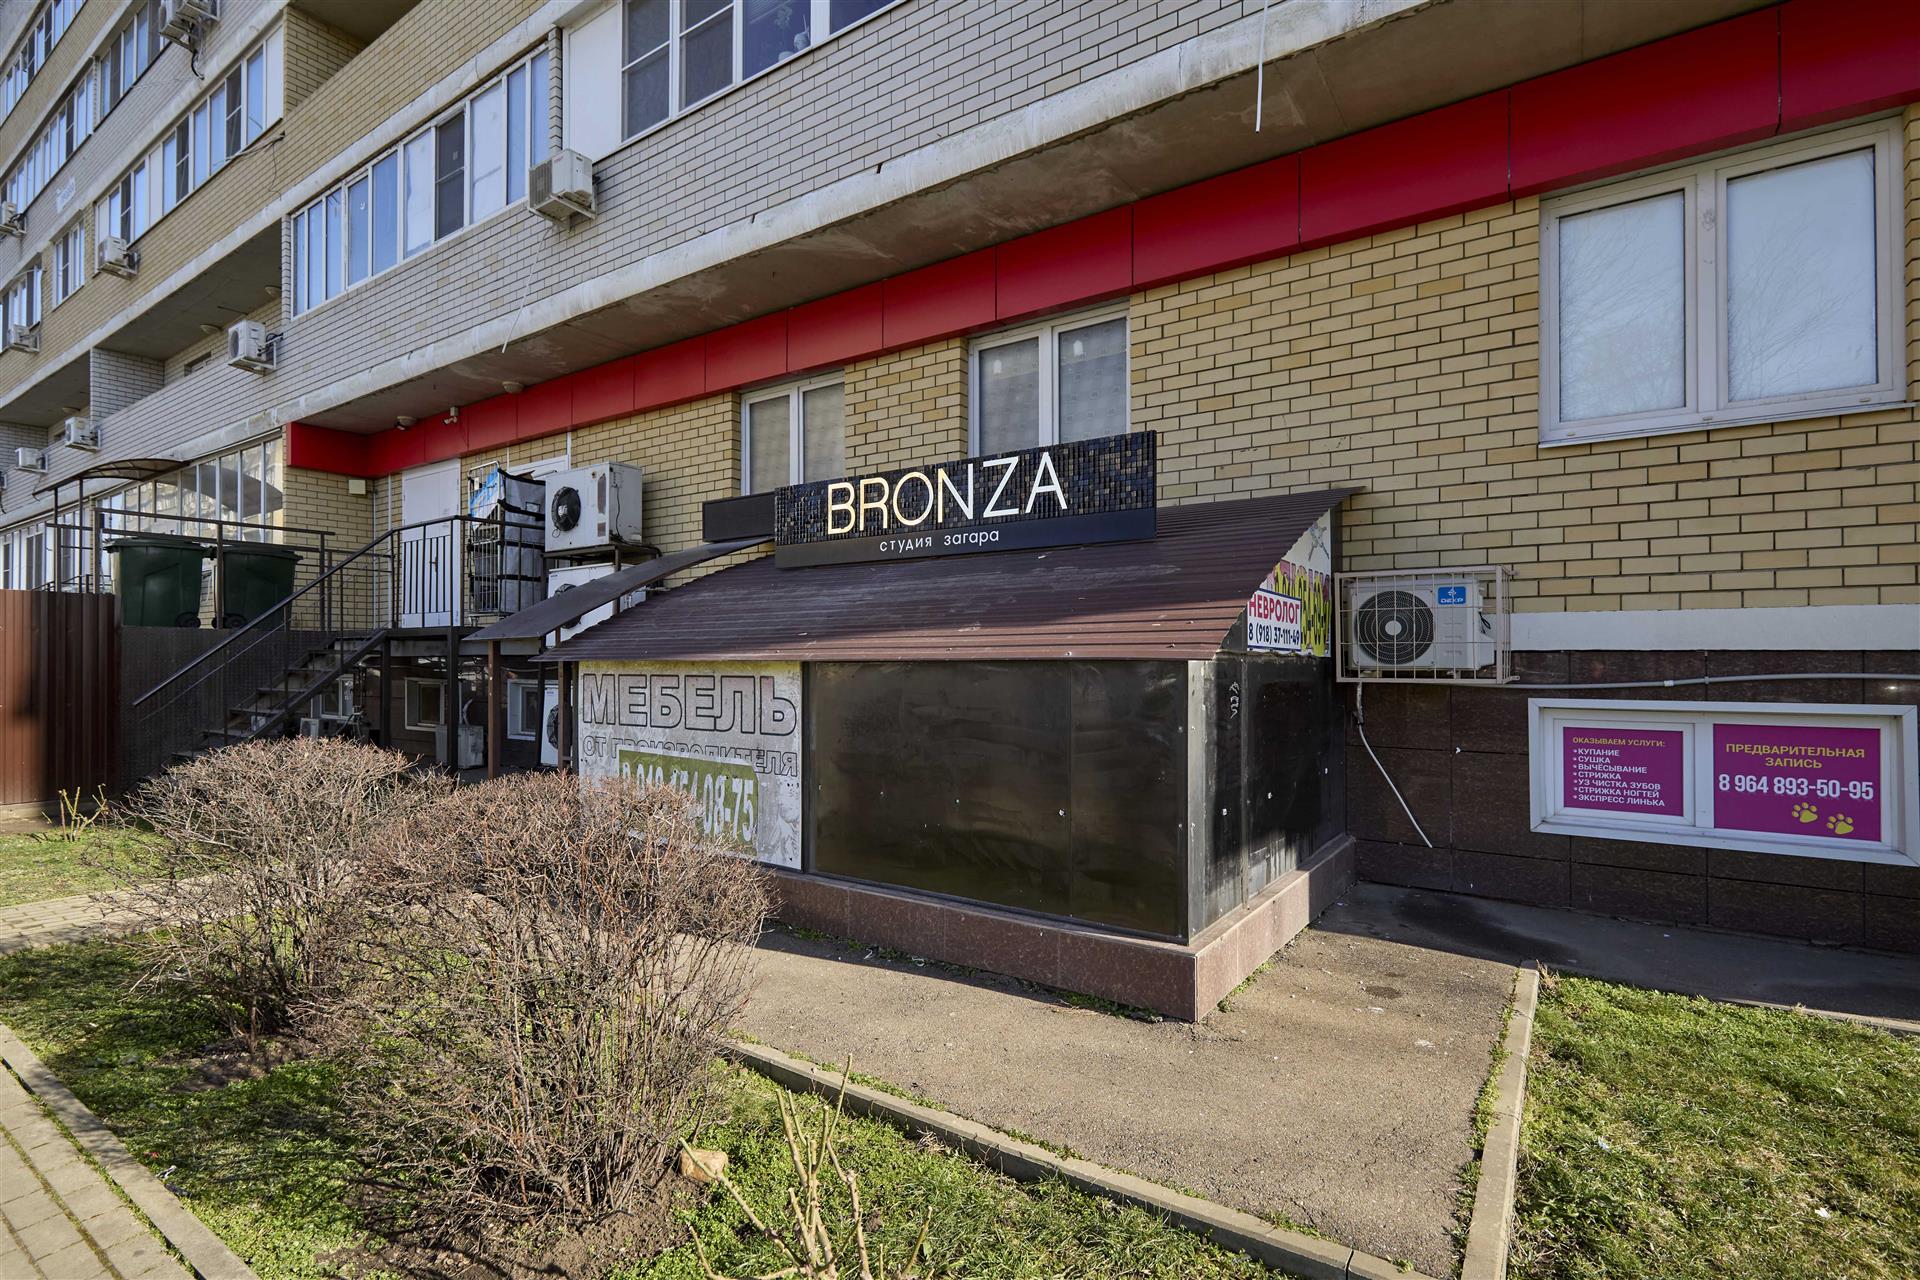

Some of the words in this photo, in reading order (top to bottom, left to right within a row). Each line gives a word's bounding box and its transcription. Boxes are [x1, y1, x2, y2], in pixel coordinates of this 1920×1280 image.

[827, 452, 1067, 535] BRONZA
[880, 536, 932, 553] студия
[944, 529, 999, 547] загара
[1249, 593, 1299, 624] НЕВРОЛОГ
[1249, 623, 1254, 641] 8
[1256, 623, 1272, 645] (918)
[1274, 627, 1300, 645] 37-111-49
[583, 673, 797, 736] МЕБЕЛЬ
[583, 736, 607, 758] ОТ
[1572, 737, 1626, 746] ОКАЗЫВАЕМ
[1627, 739, 1665, 747] УСЛУГИ:
[1578, 748, 1620, 756] КУПАНИЕ
[1725, 743, 1865, 758] ПРЕДВАРИТЕЛЬНАЯ
[1578, 756, 1611, 764] СУШКА
[1765, 757, 1822, 769] ЗАПИСЬ
[1578, 771, 1621, 780] СТРИЖКА
[1592, 780, 1628, 788] ЧИСТКА
[1718, 774, 1730, 791] 8
[1734, 775, 1768, 793] 964
[1774, 777, 1874, 800] 893-50-95
[1578, 786, 1621, 796] СТРИЖКА
[1623, 788, 1660, 798] НОГТЕЙ
[1578, 794, 1625, 804] ЭКСПРЕСС
[1627, 798, 1665, 807] ЛИНЬКА
